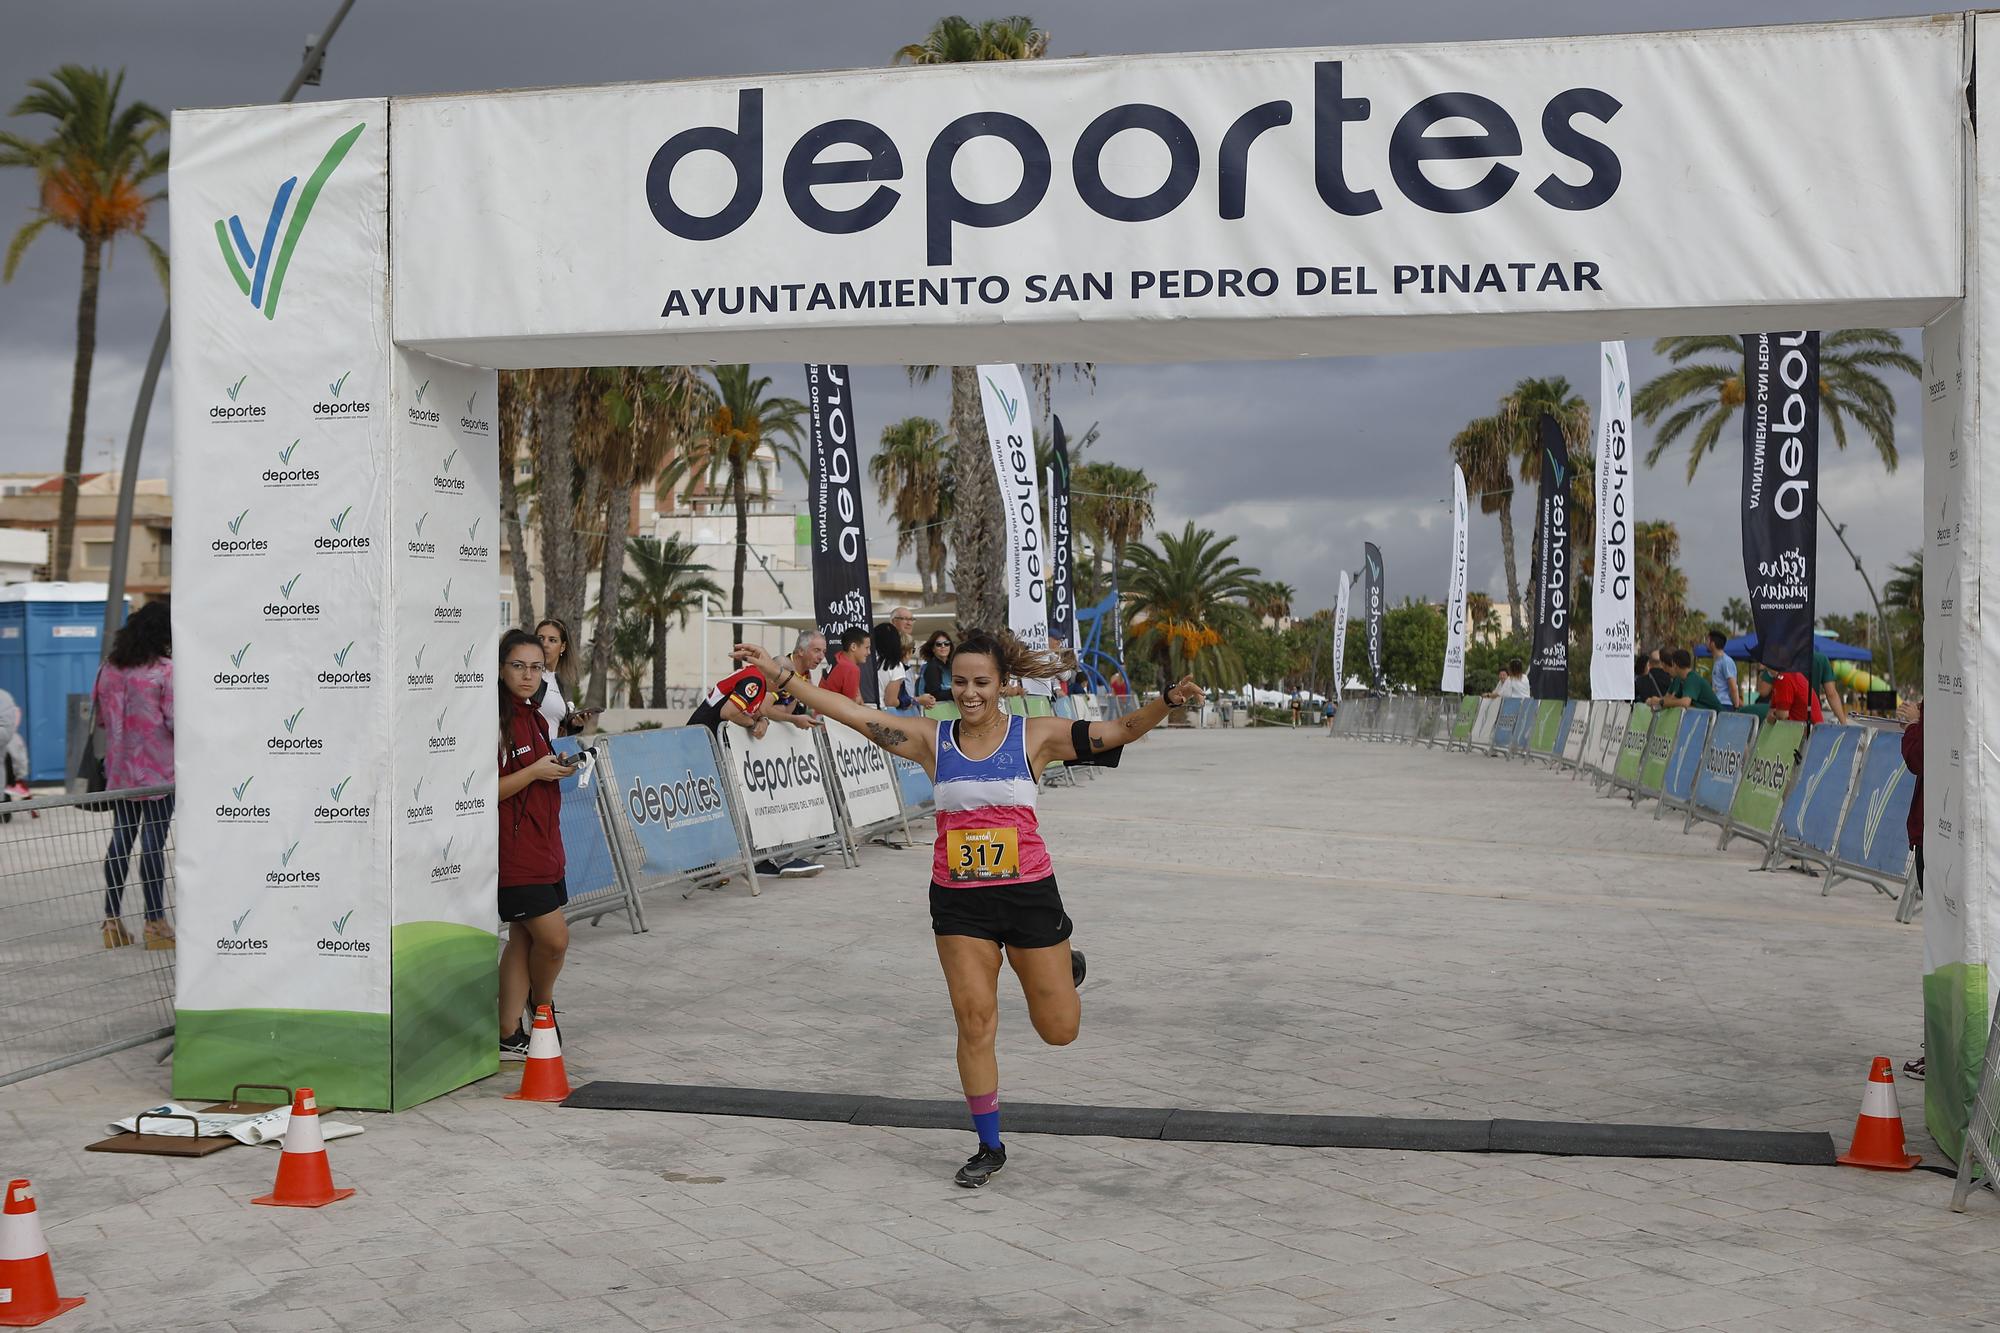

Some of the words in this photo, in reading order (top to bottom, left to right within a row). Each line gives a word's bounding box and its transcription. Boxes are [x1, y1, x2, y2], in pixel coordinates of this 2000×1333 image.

[645, 61, 1624, 267] deportes
[660, 273, 1010, 318] AYUNTAMIENTO
[1025, 271, 1113, 303] SAN
[1131, 267, 1279, 299] PEDRO
[1296, 266, 1378, 296] DEL
[1393, 261, 1603, 295] PINATAR
[210, 405, 266, 420] deportes
[313, 400, 370, 416] deportes
[409, 406, 440, 422] deportes
[460, 416, 489, 431] deportes
[262, 468, 319, 483] deportes
[433, 475, 465, 489] deportes
[212, 538, 268, 553] deportes
[314, 536, 370, 550] deportes
[408, 539, 435, 553] deportes
[459, 544, 488, 557] deportes
[263, 603, 320, 617] deportes
[434, 605, 462, 619] deportes
[213, 672, 269, 686] deportes
[317, 670, 371, 685] deportes
[407, 672, 433, 686] deportes
[454, 671, 484, 685] deportes
[267, 736, 322, 750] deportes
[428, 735, 456, 748] deportes
[836, 740, 885, 785] deportes
[743, 747, 820, 800] deportes
[454, 797, 485, 811] deportes
[628, 768, 722, 832] deportes
[216, 804, 270, 819] deportes
[314, 805, 370, 819] deportes
[407, 804, 433, 819] deportes
[960, 843, 1004, 867] 317
[266, 870, 320, 884] deportes
[431, 863, 461, 878] deportes
[217, 937, 268, 951] deportes
[317, 938, 370, 952] deportes
